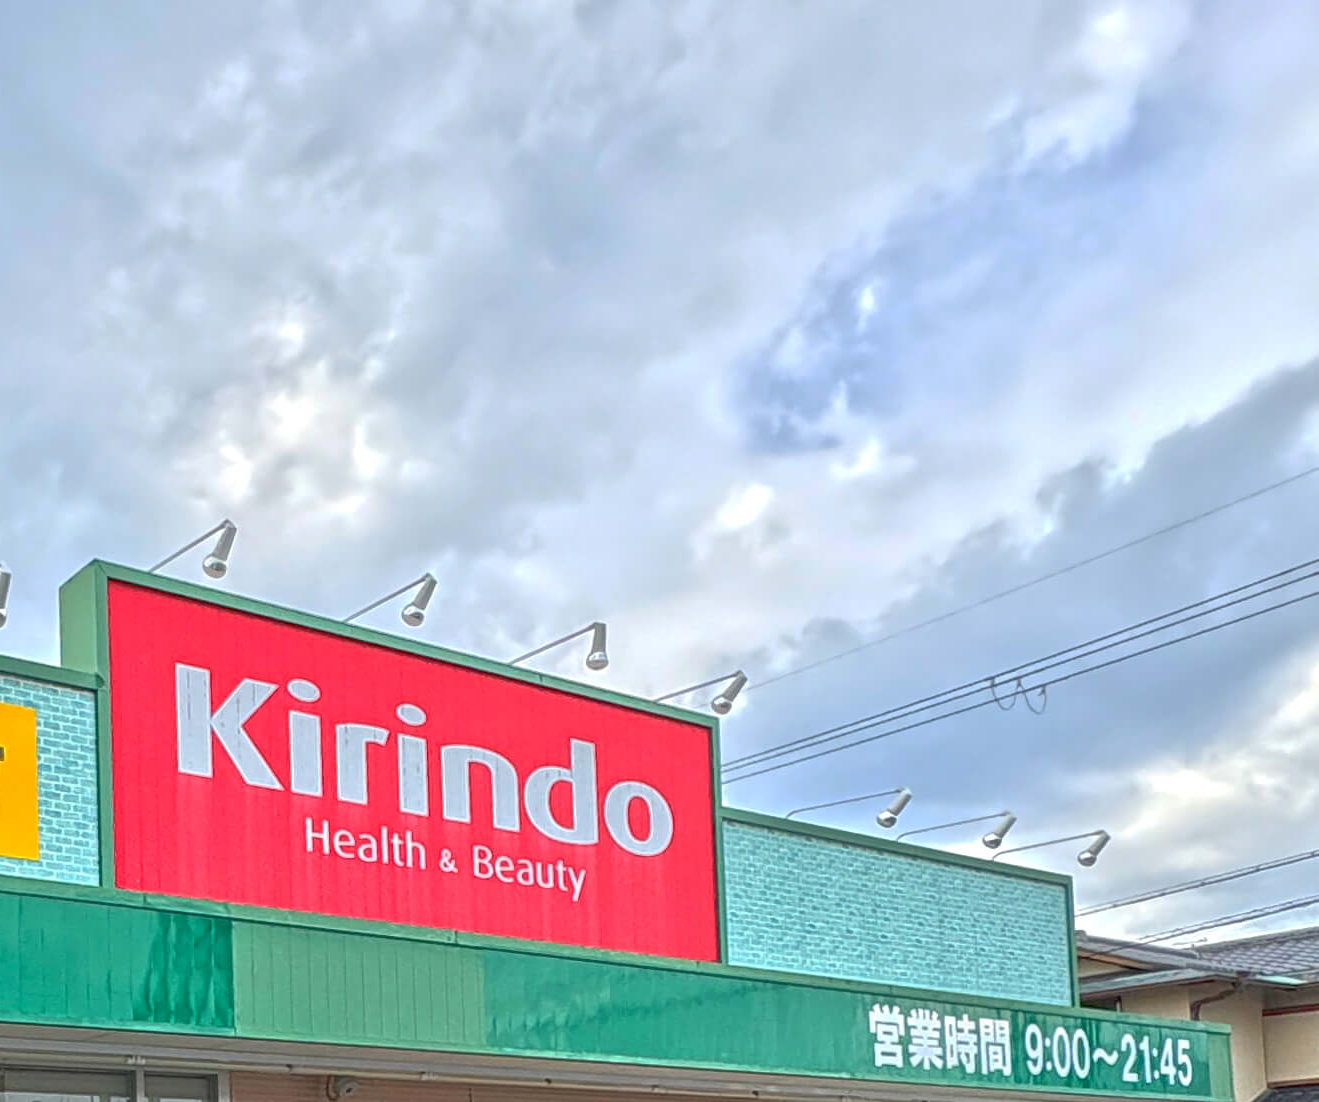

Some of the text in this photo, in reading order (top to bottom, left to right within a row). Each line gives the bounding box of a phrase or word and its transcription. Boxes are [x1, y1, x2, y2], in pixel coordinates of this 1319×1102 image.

[175, 662, 674, 857] Kirindo
[305, 817, 586, 902] Health & Beauty
[869, 1003, 1012, 1077] 営業時間
